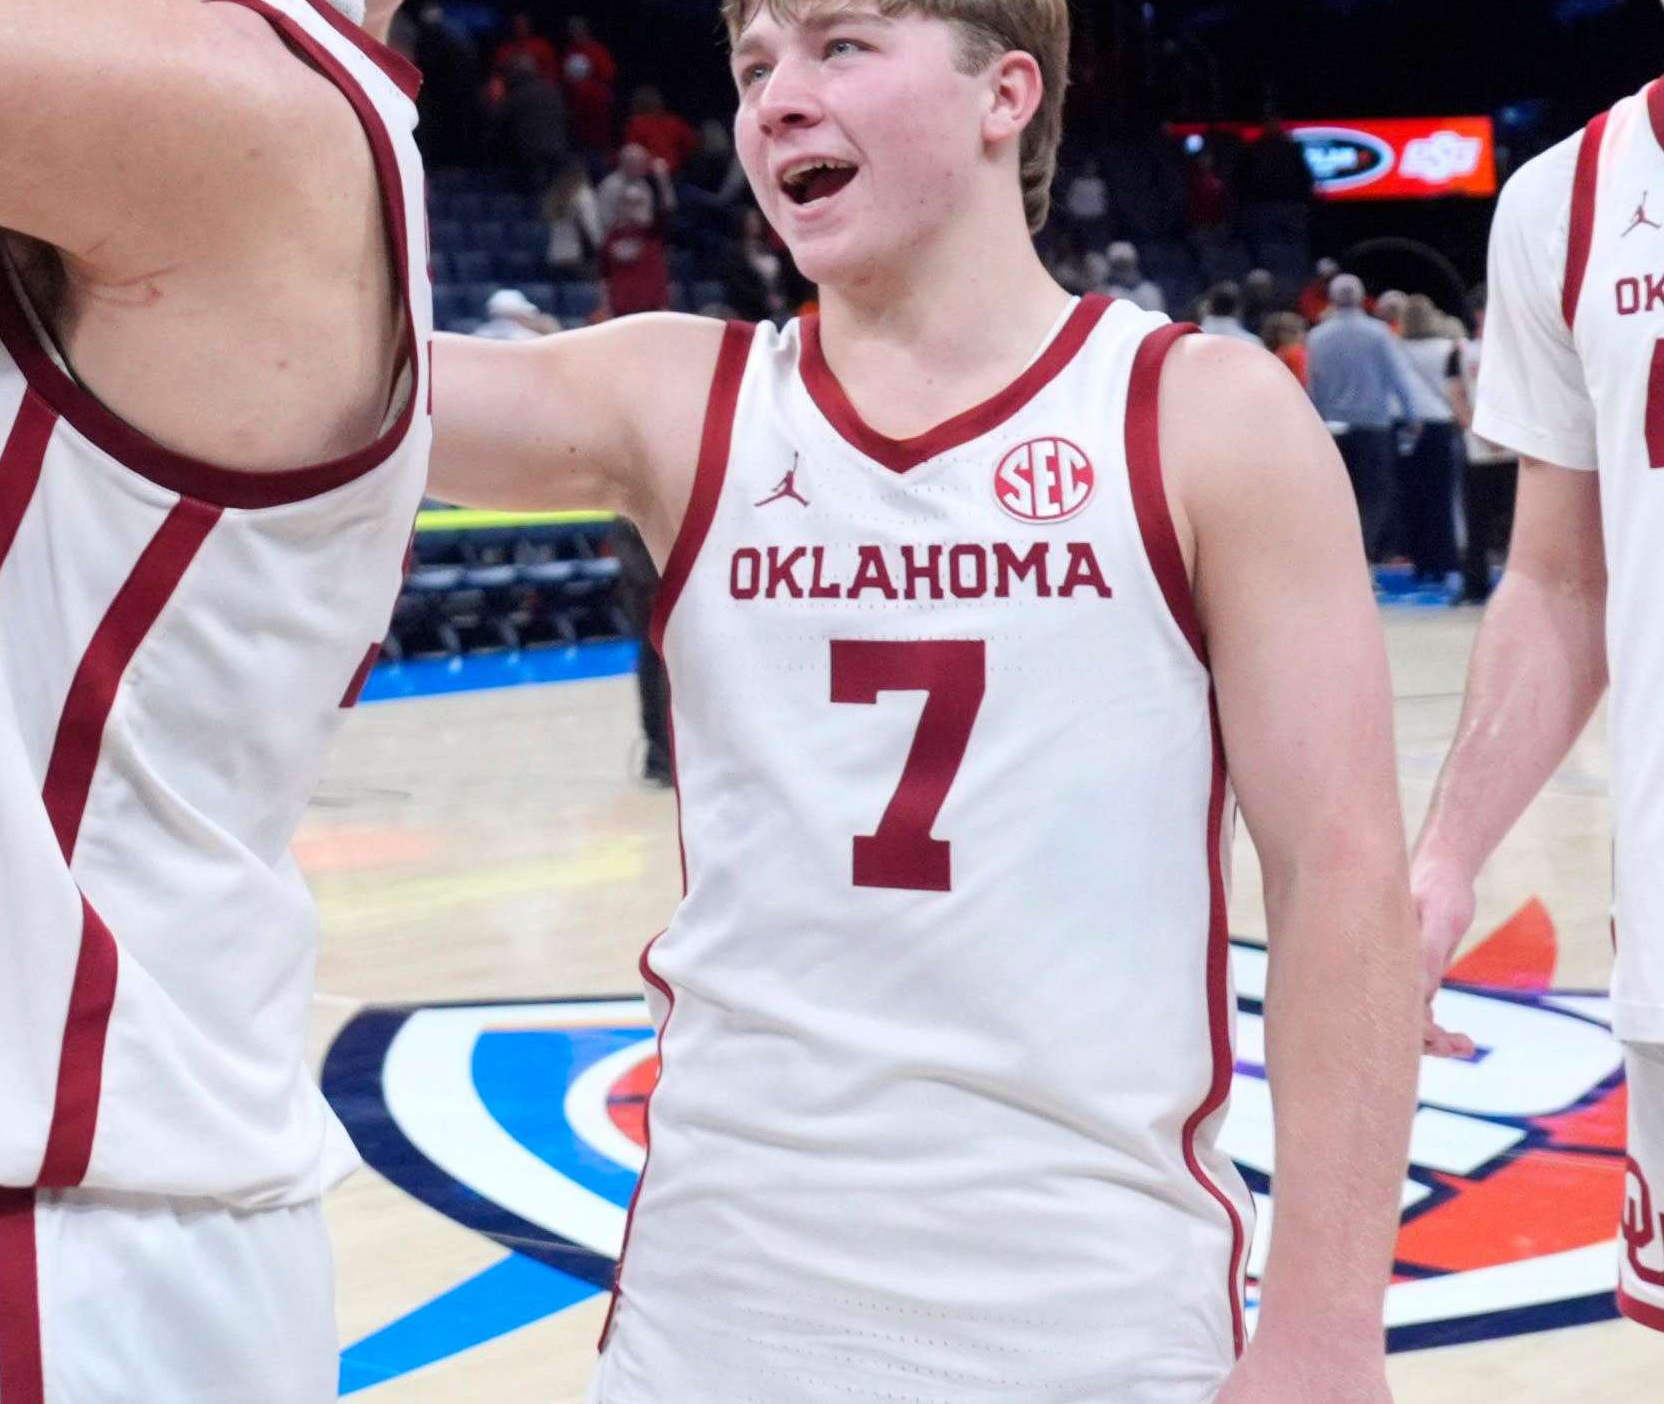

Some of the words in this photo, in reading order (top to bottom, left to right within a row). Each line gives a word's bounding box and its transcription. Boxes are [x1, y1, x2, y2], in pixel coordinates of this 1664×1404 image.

[999, 438, 1092, 520] SEC
[729, 541, 1112, 600] OKLAHOMA
[829, 639, 987, 892] 7
